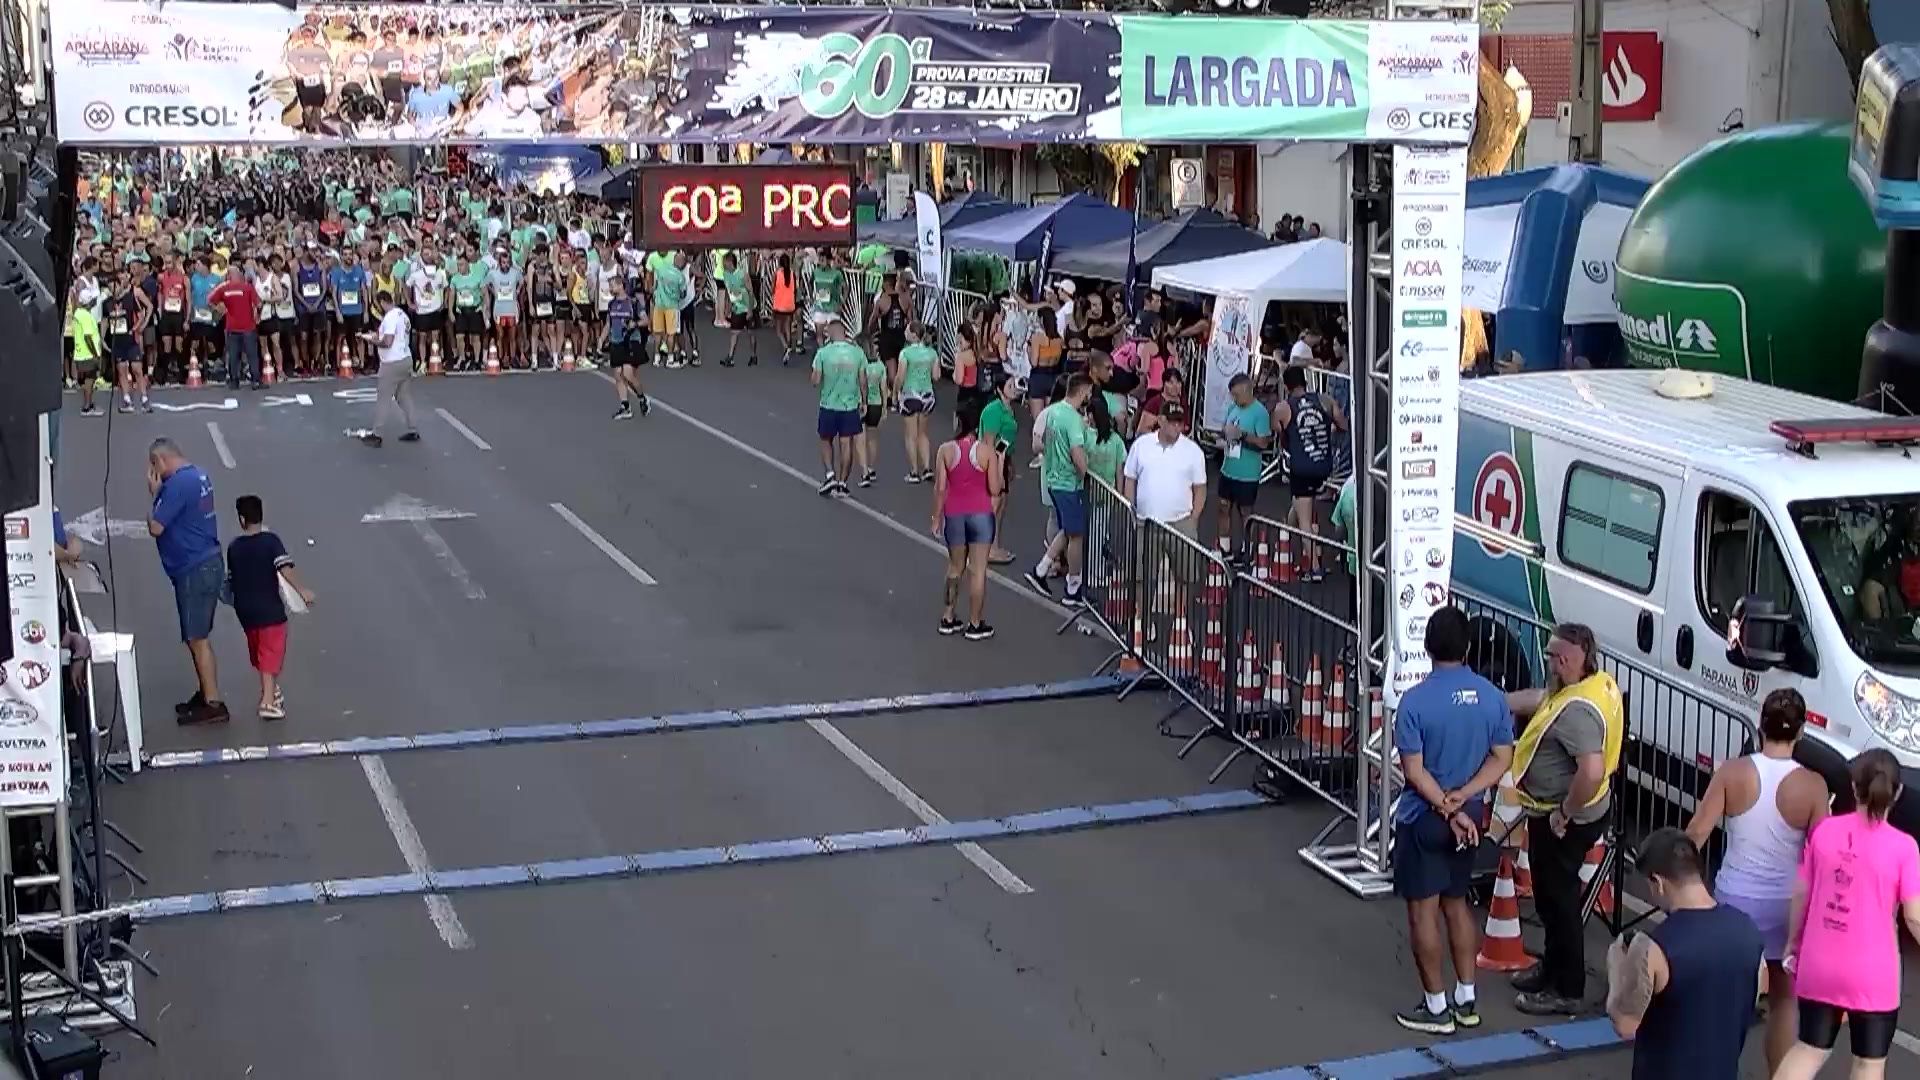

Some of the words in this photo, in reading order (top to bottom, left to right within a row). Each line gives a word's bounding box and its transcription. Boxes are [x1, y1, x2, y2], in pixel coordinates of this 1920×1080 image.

[916, 67, 966, 81] PROVA
[967, 67, 1043, 82] PEDESTRE
[1144, 55, 1357, 107] LARGADA
[912, 86, 946, 109] 28
[949, 91, 967, 105] DE
[967, 87, 1073, 111] JANEIRO
[125, 106, 237, 127] CRESOL
[1419, 111, 1473, 130] CRES
[662, 184, 742, 230] 60ª
